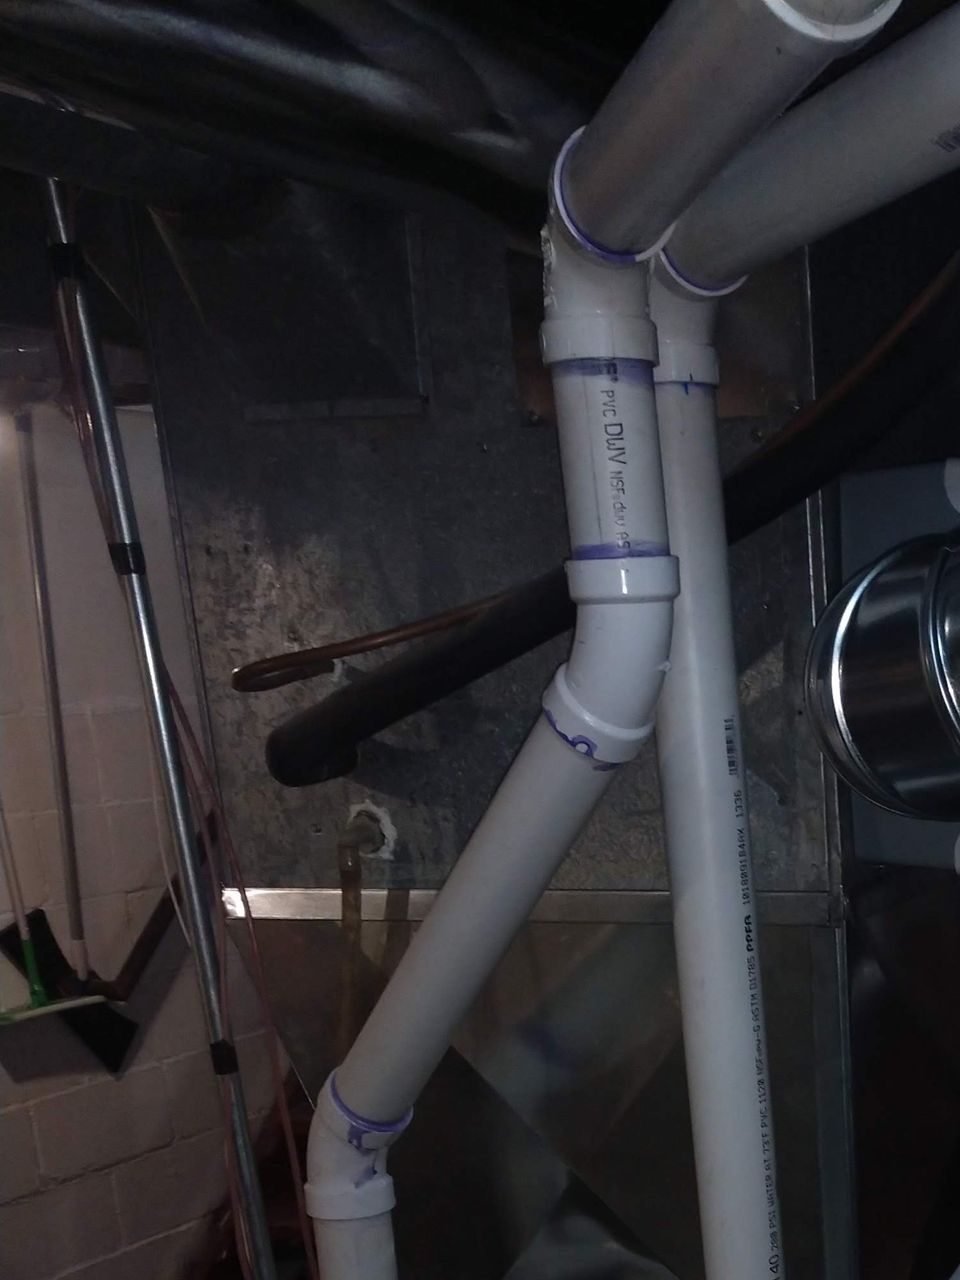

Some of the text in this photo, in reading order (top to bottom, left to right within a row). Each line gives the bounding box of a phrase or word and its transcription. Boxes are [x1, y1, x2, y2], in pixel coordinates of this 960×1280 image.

[601, 389, 617, 417] PVC
[604, 423, 626, 465] DWV
[770, 1254, 780, 1274] 40
